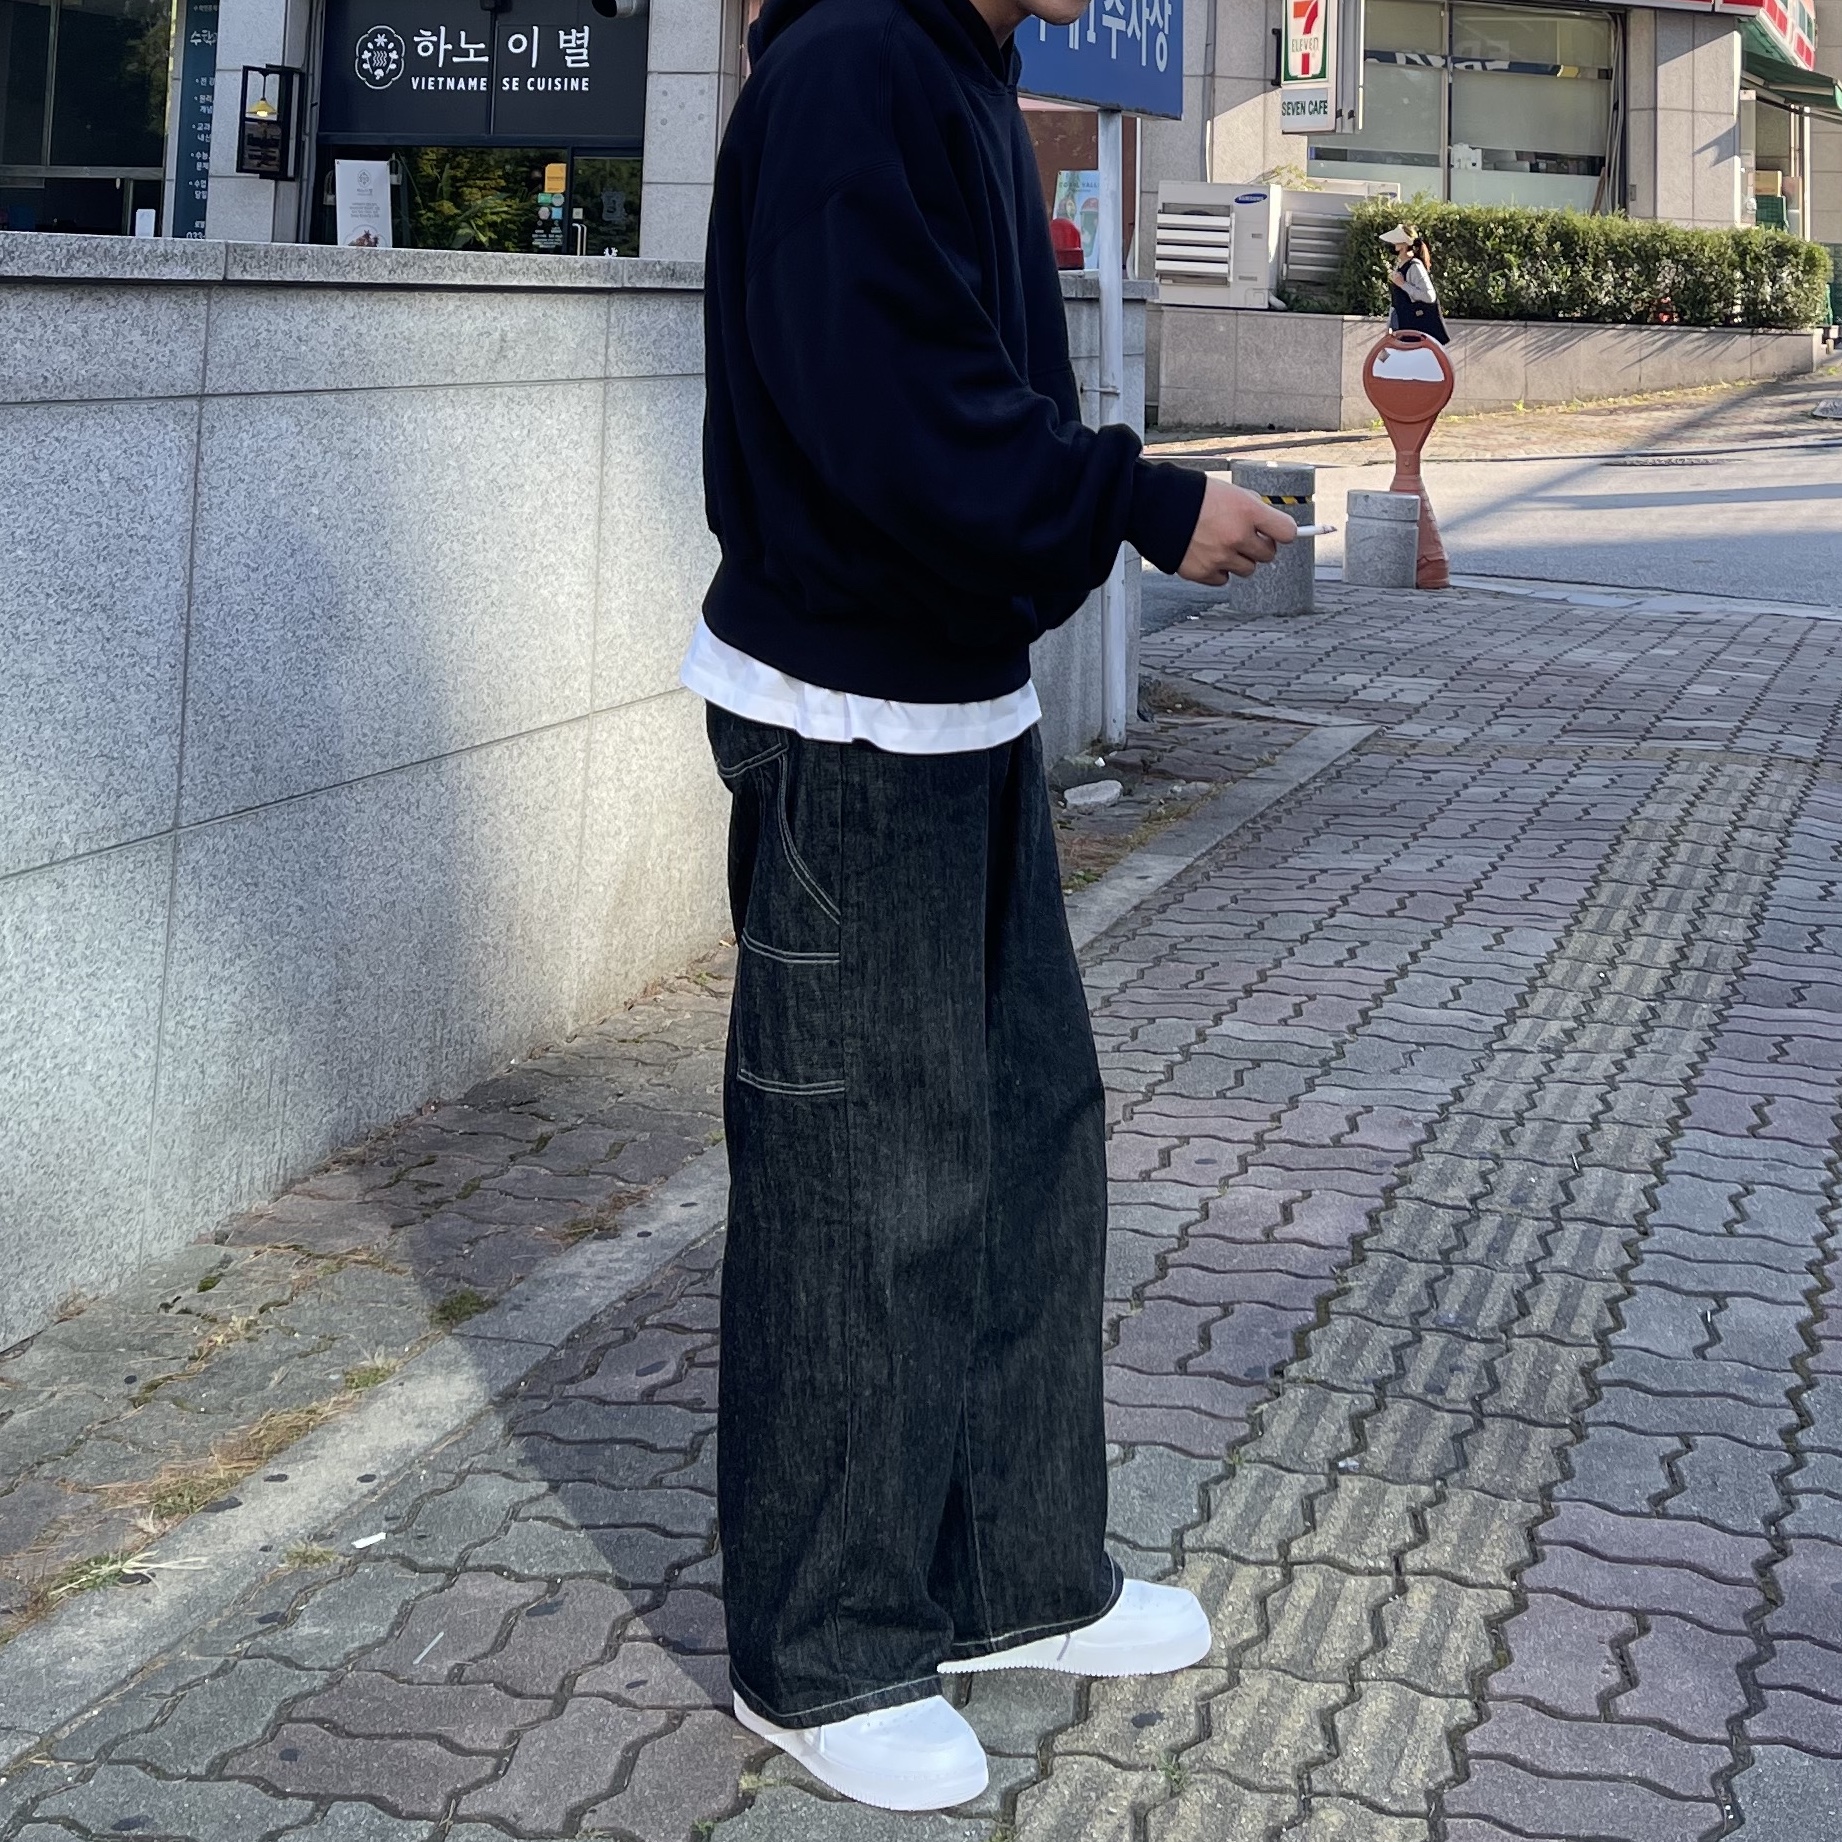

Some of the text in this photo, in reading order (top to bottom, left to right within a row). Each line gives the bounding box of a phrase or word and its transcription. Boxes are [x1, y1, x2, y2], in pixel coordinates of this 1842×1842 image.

[526, 76, 590, 91] CUISINE
[1281, 100, 1328, 116] SEVEN CAFE
